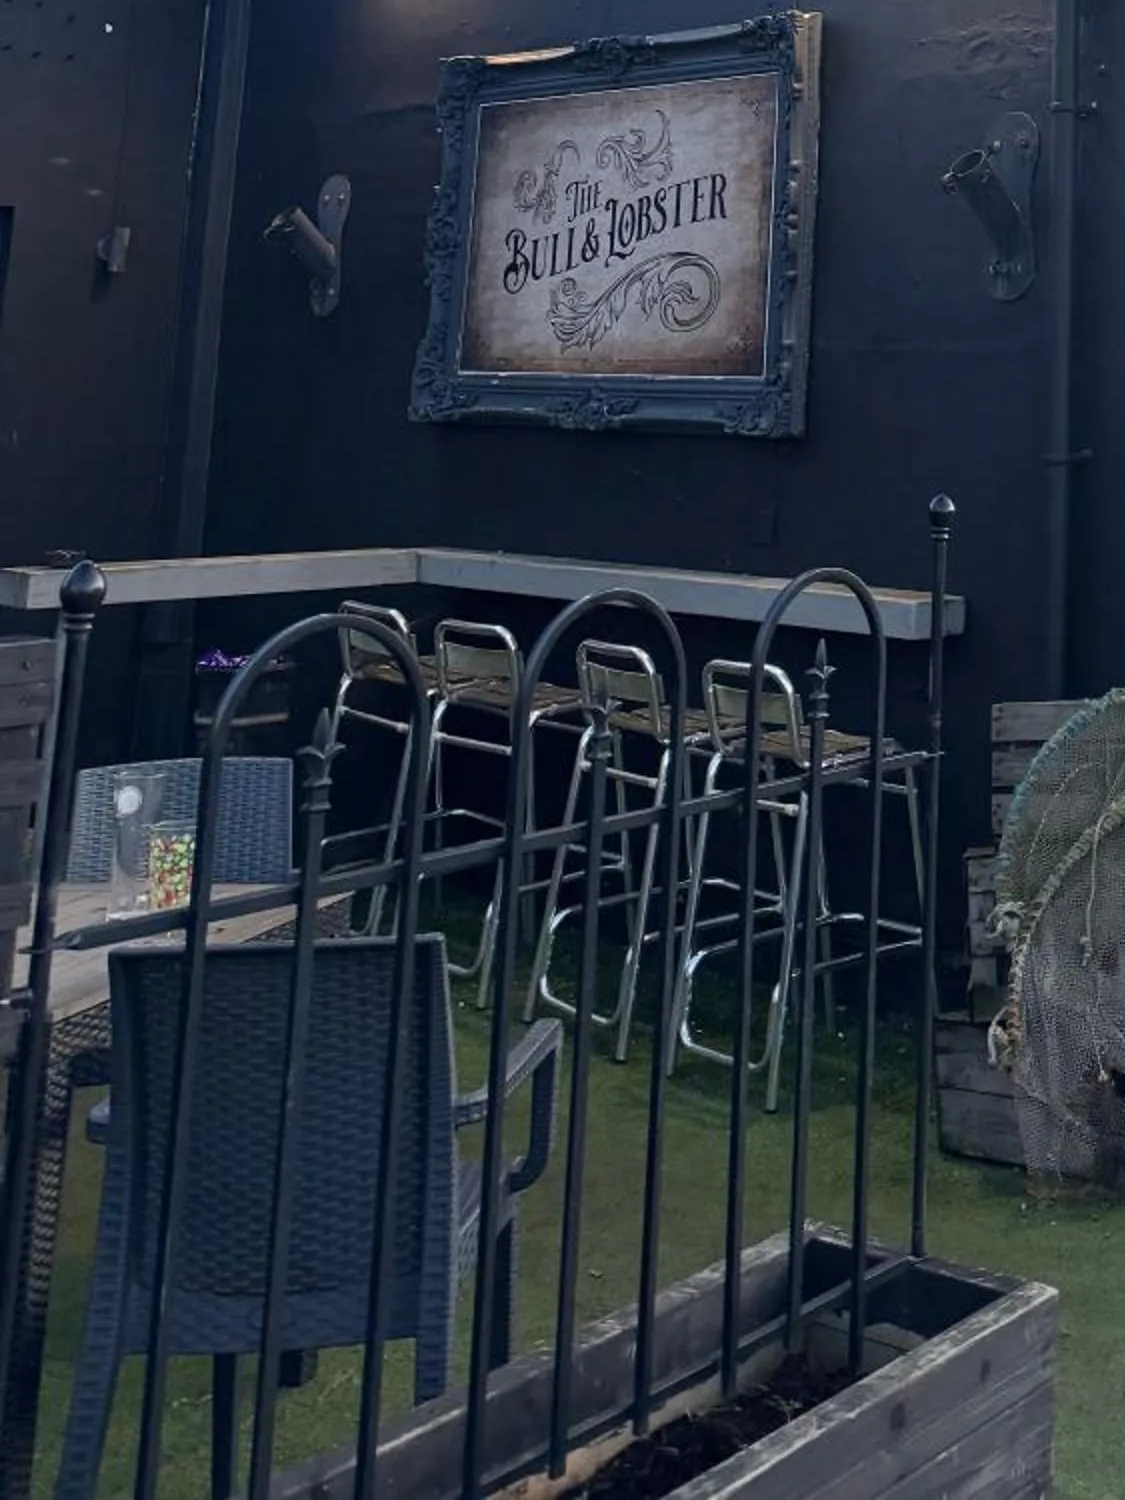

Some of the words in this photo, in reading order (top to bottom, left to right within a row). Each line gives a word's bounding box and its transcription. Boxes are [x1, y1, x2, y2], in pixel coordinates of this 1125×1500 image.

[503, 227, 579, 295] BULL
[604, 173, 728, 268] LOBSTER
[565, 177, 603, 223] THE
